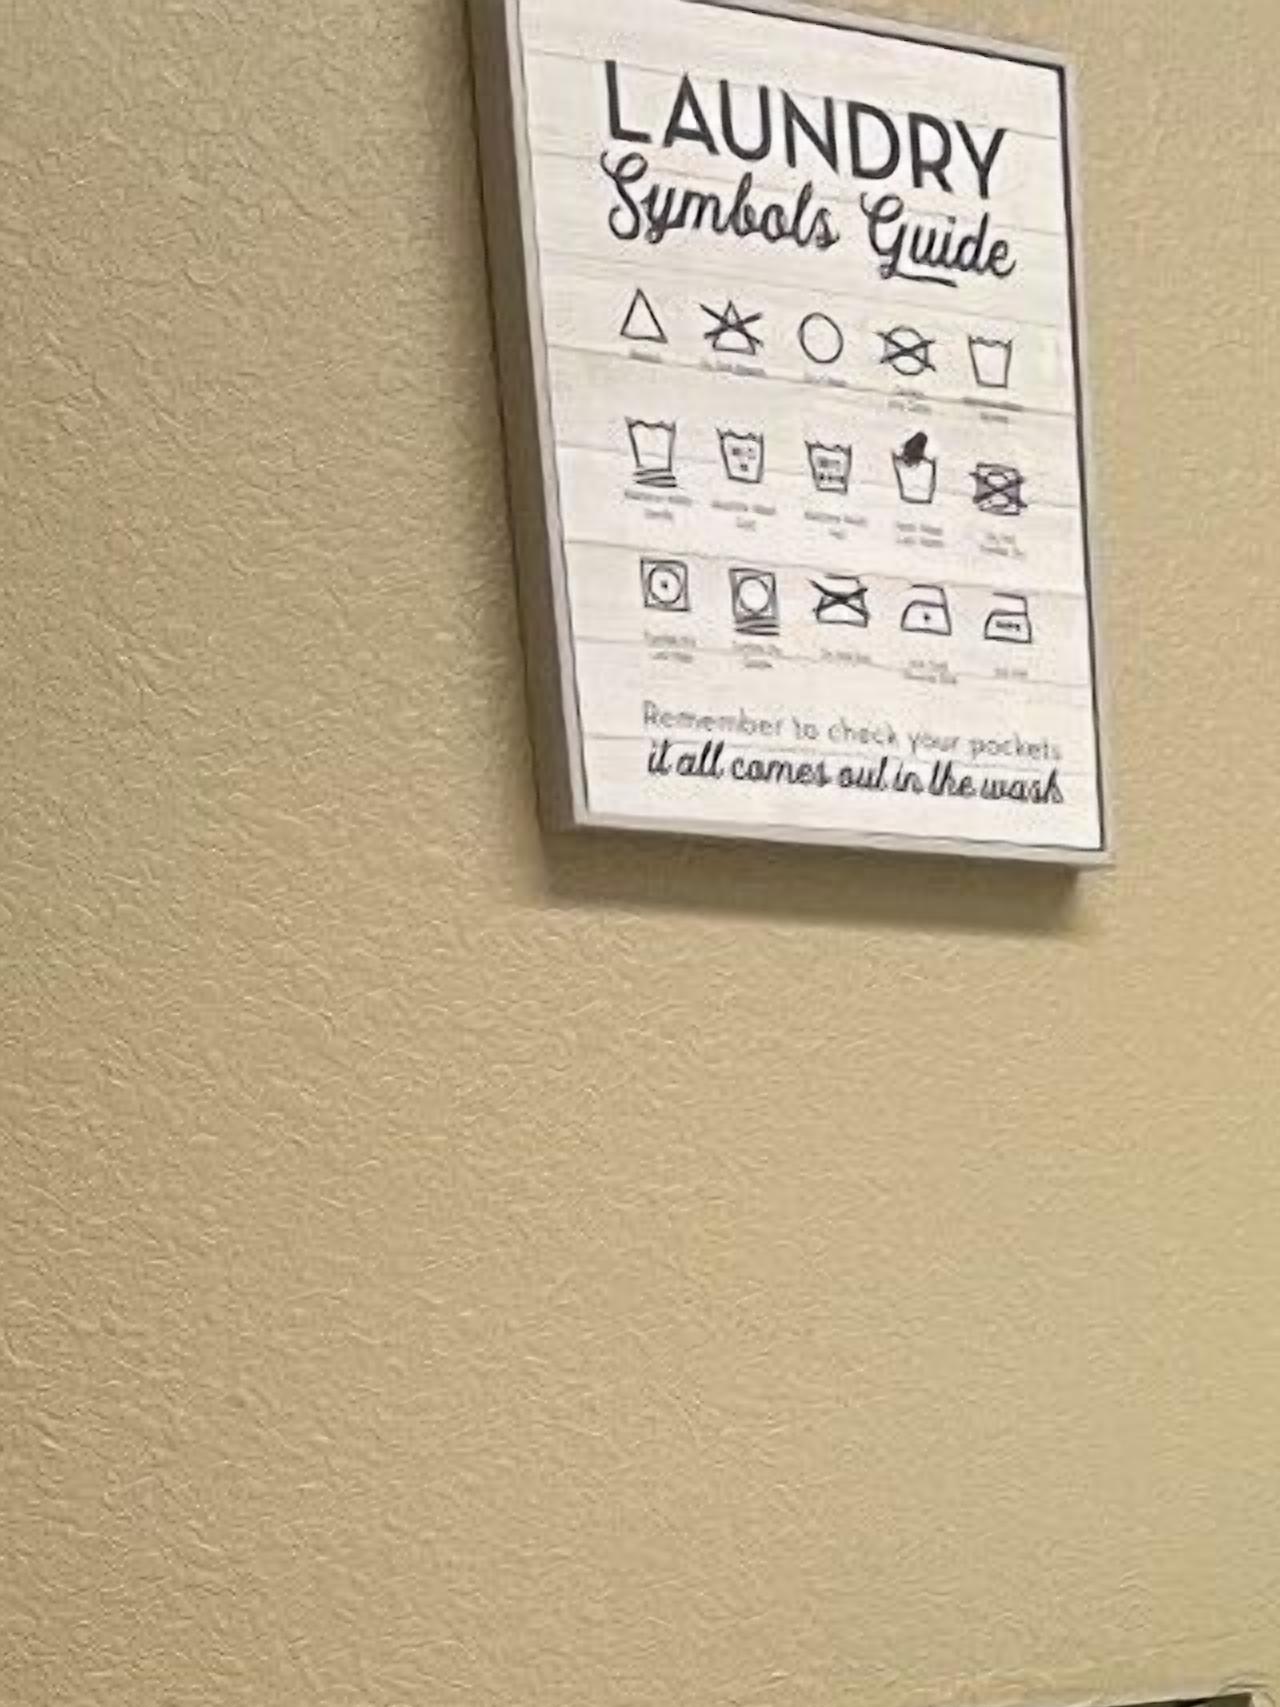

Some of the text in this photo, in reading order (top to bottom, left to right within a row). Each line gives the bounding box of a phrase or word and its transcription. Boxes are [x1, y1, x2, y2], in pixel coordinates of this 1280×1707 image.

[603, 59, 1008, 200] LAUNDRY
[600, 148, 1017, 288] Symbols Guide
[642, 700, 1062, 762] Remember to check your pockets
[648, 737, 1064, 805] it all comes out in the wash
